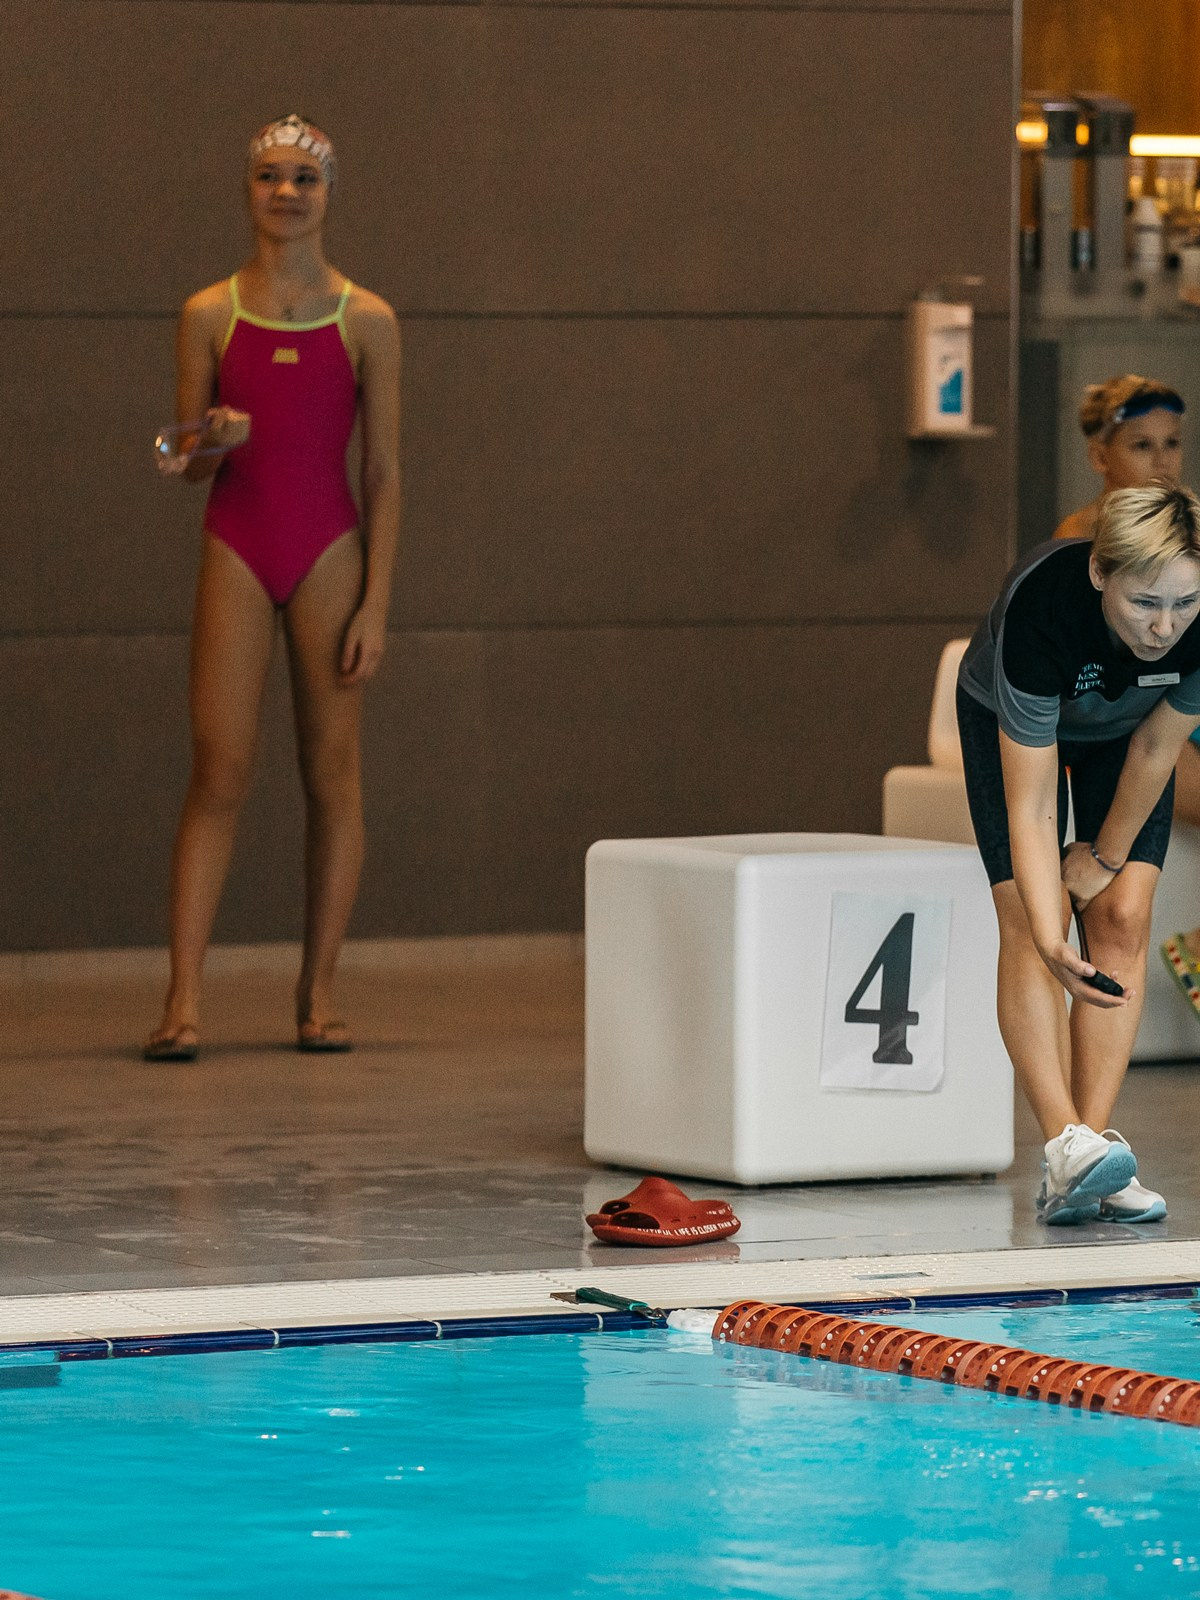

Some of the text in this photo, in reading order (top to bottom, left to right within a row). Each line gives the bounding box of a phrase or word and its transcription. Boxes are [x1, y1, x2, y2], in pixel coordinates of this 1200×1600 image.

[844, 912, 920, 1065] 4
[674, 1227, 691, 1236] LIFE
[690, 1226, 698, 1235] IS
[697, 1223, 718, 1234] CLOSER
[717, 1221, 732, 1230] THAN
